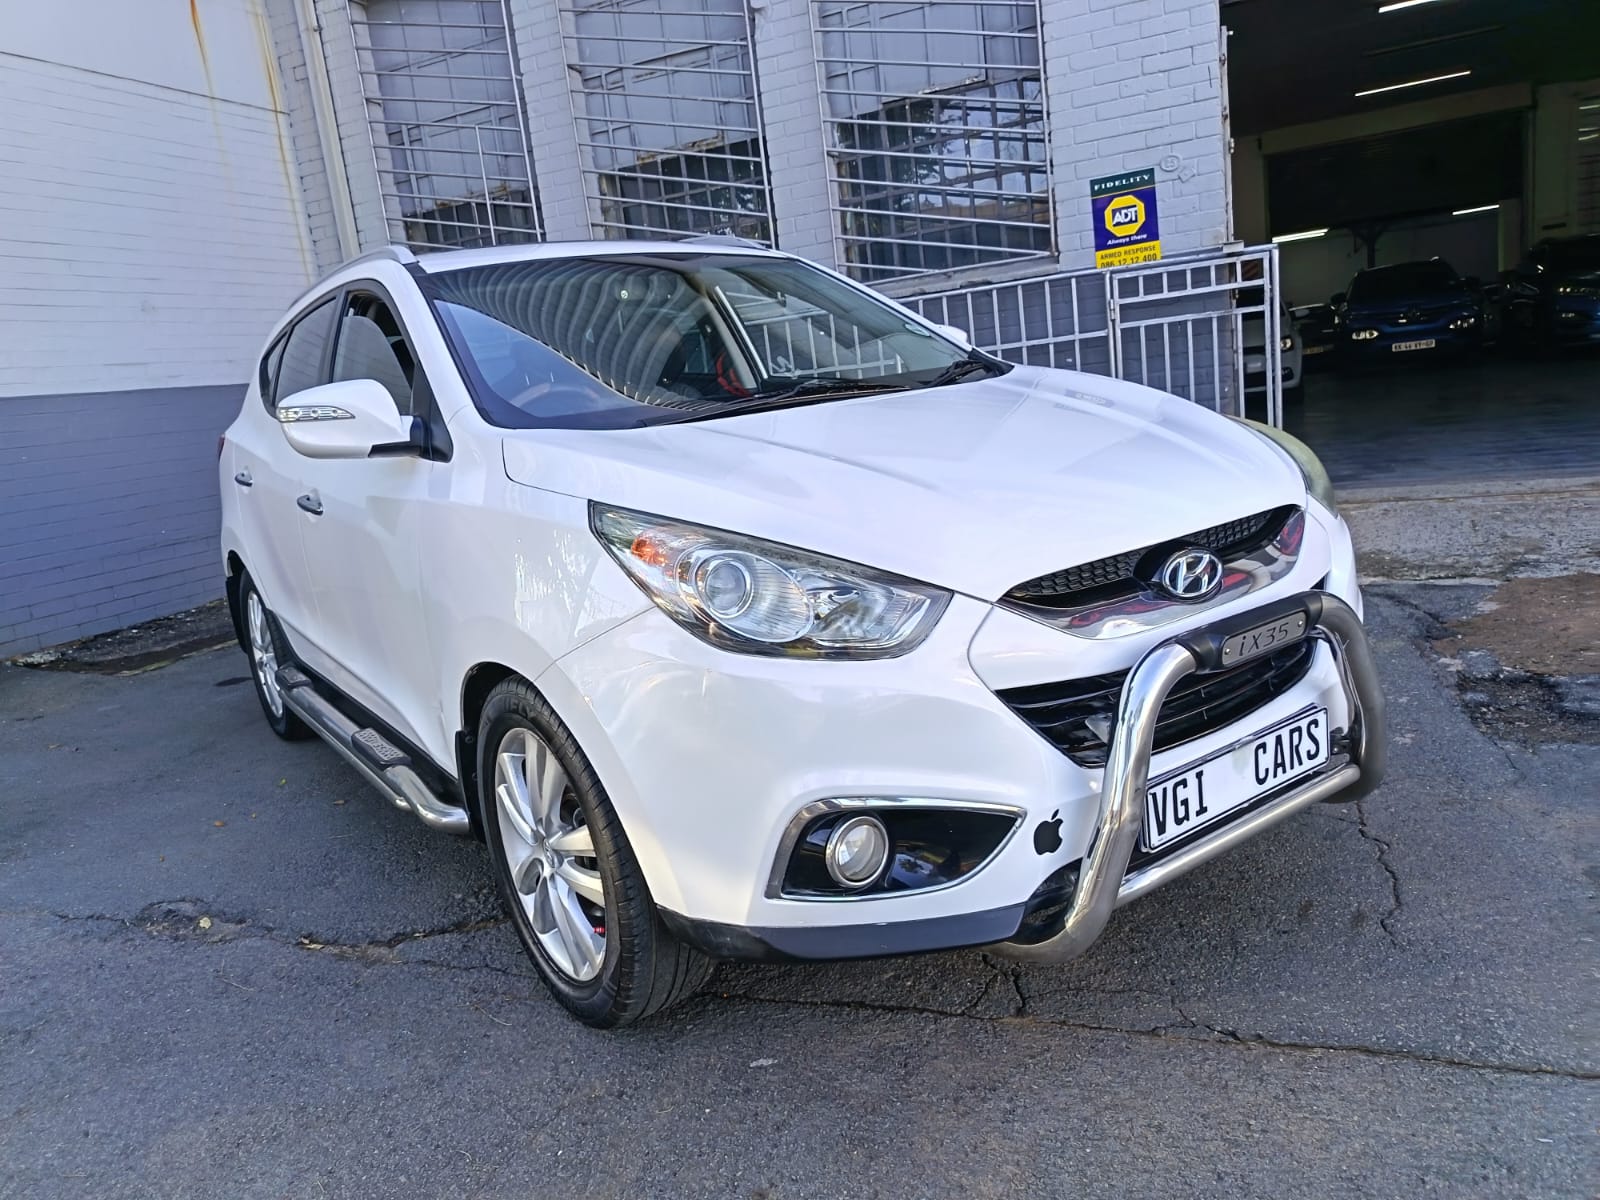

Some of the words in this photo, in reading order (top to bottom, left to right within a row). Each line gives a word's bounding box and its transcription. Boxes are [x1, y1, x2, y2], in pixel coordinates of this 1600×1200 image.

[1094, 174, 1150, 191] FIDELITY
[1112, 207, 1138, 225] ADT
[1100, 251, 1122, 260] ARMED
[1124, 245, 1156, 256] RESPONSE
[1149, 770, 1208, 837] VGI
[1254, 718, 1320, 786] CARS
